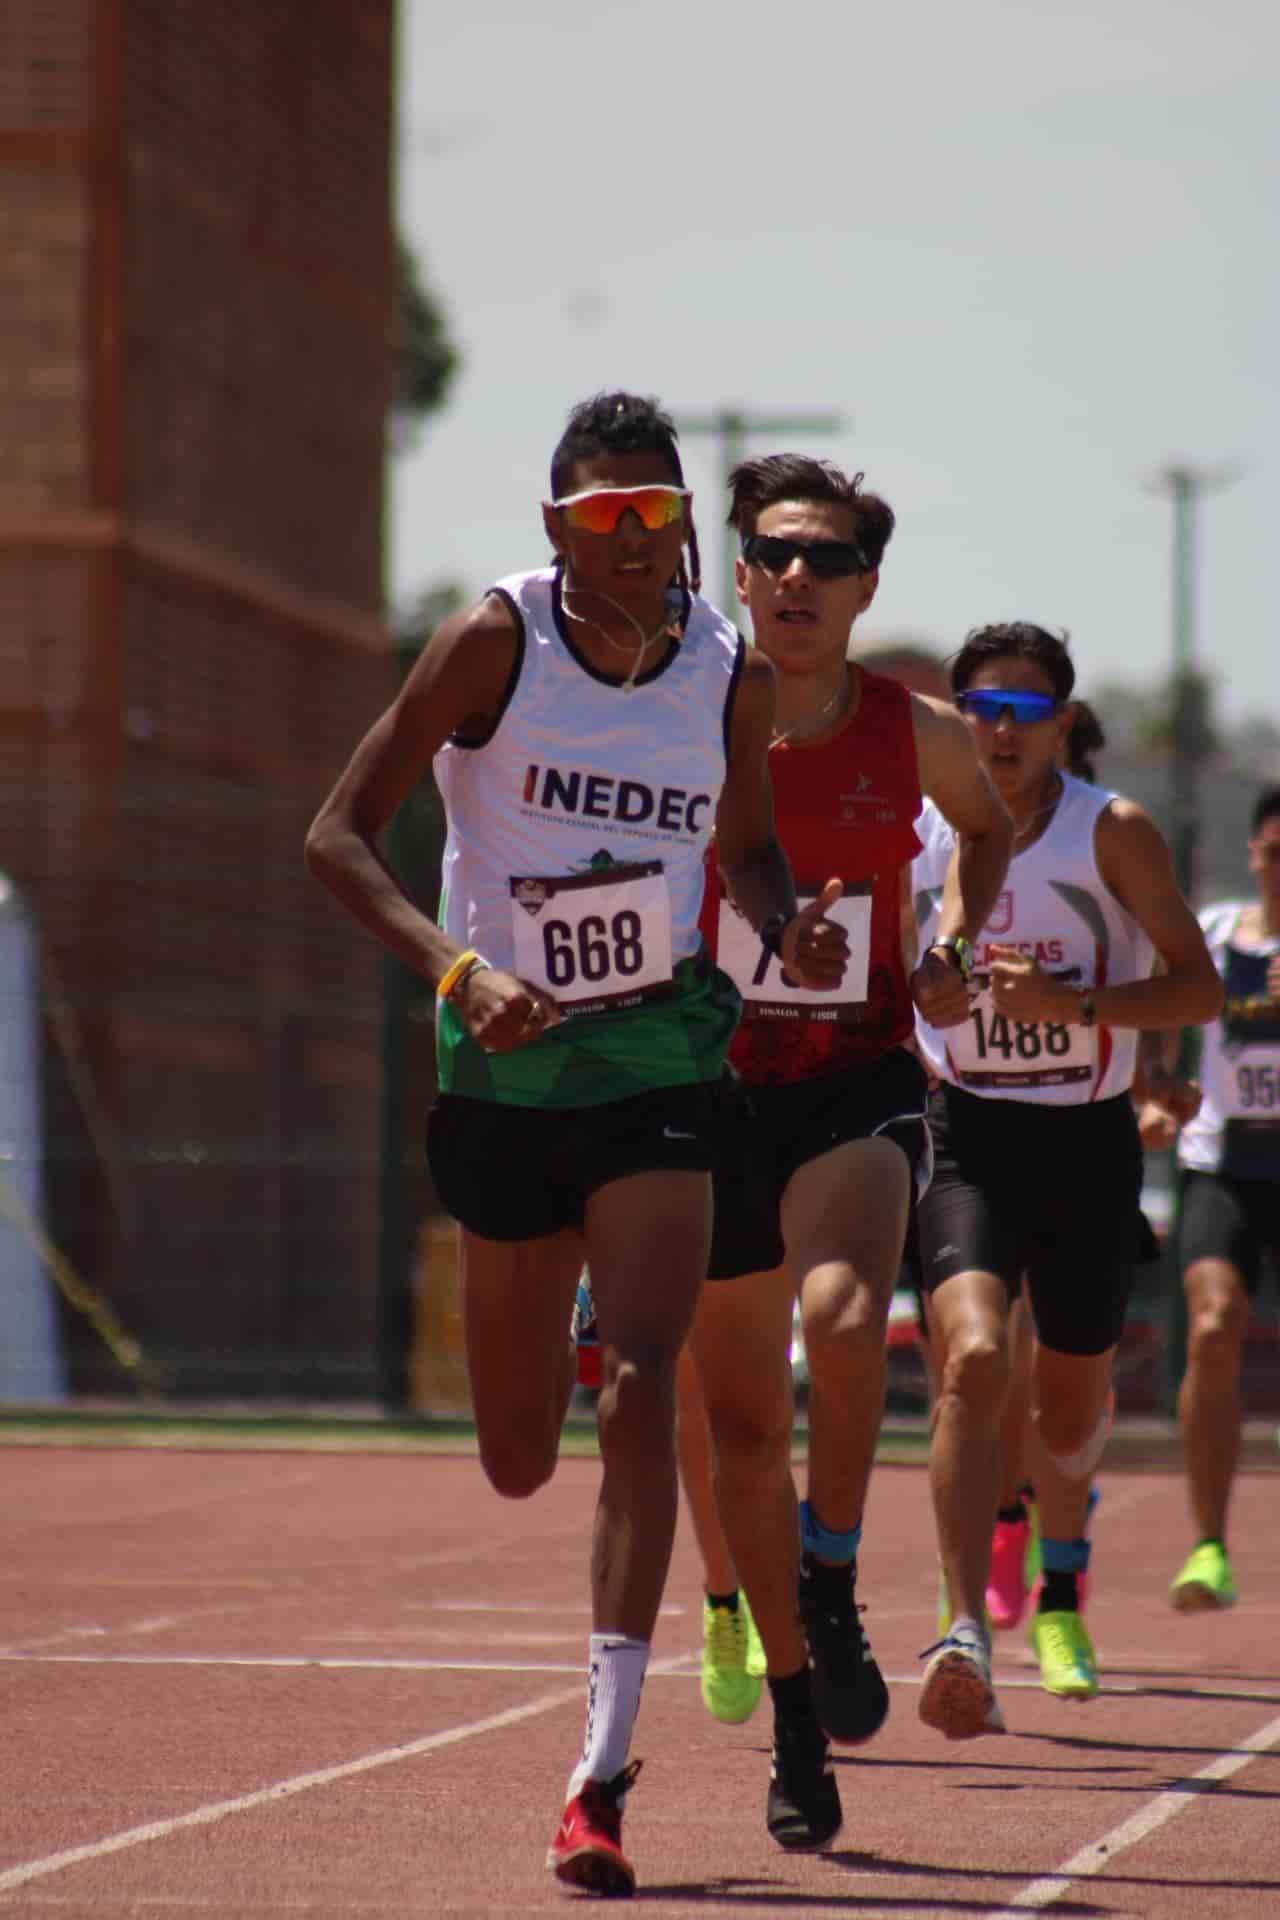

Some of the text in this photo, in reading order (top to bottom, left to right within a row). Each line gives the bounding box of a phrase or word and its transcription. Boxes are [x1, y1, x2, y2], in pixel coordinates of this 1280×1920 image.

[523, 764, 711, 833] INEDEC
[543, 910, 643, 987] 668
[970, 1007, 1071, 1060] 1488
